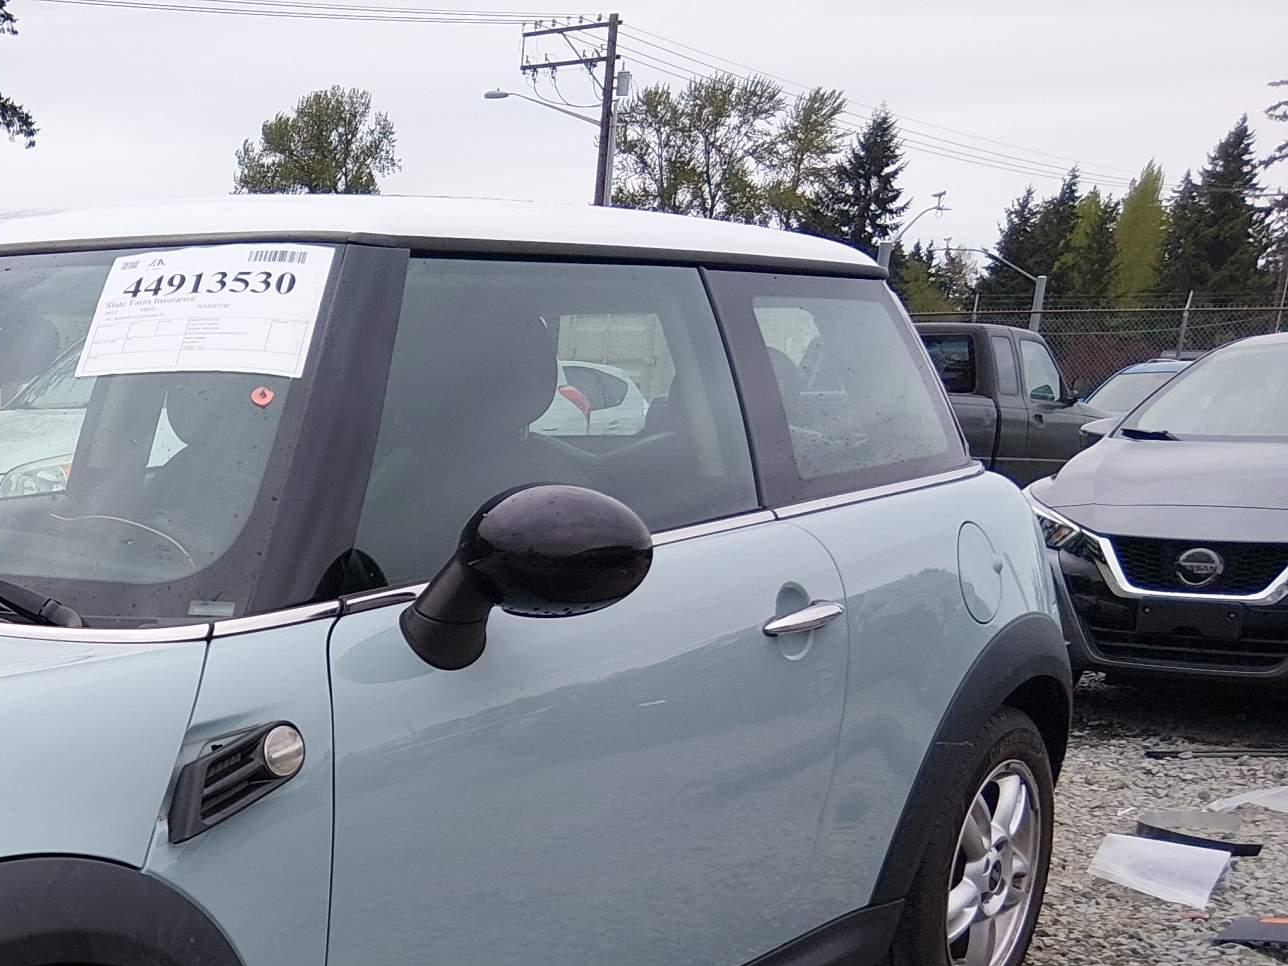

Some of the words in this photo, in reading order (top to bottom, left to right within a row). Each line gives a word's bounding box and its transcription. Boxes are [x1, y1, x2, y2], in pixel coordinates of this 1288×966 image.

[122, 271, 296, 298] 44913530
[105, 301, 126, 309] State
[129, 299, 151, 307] Farm
[154, 296, 196, 305] Insurance
